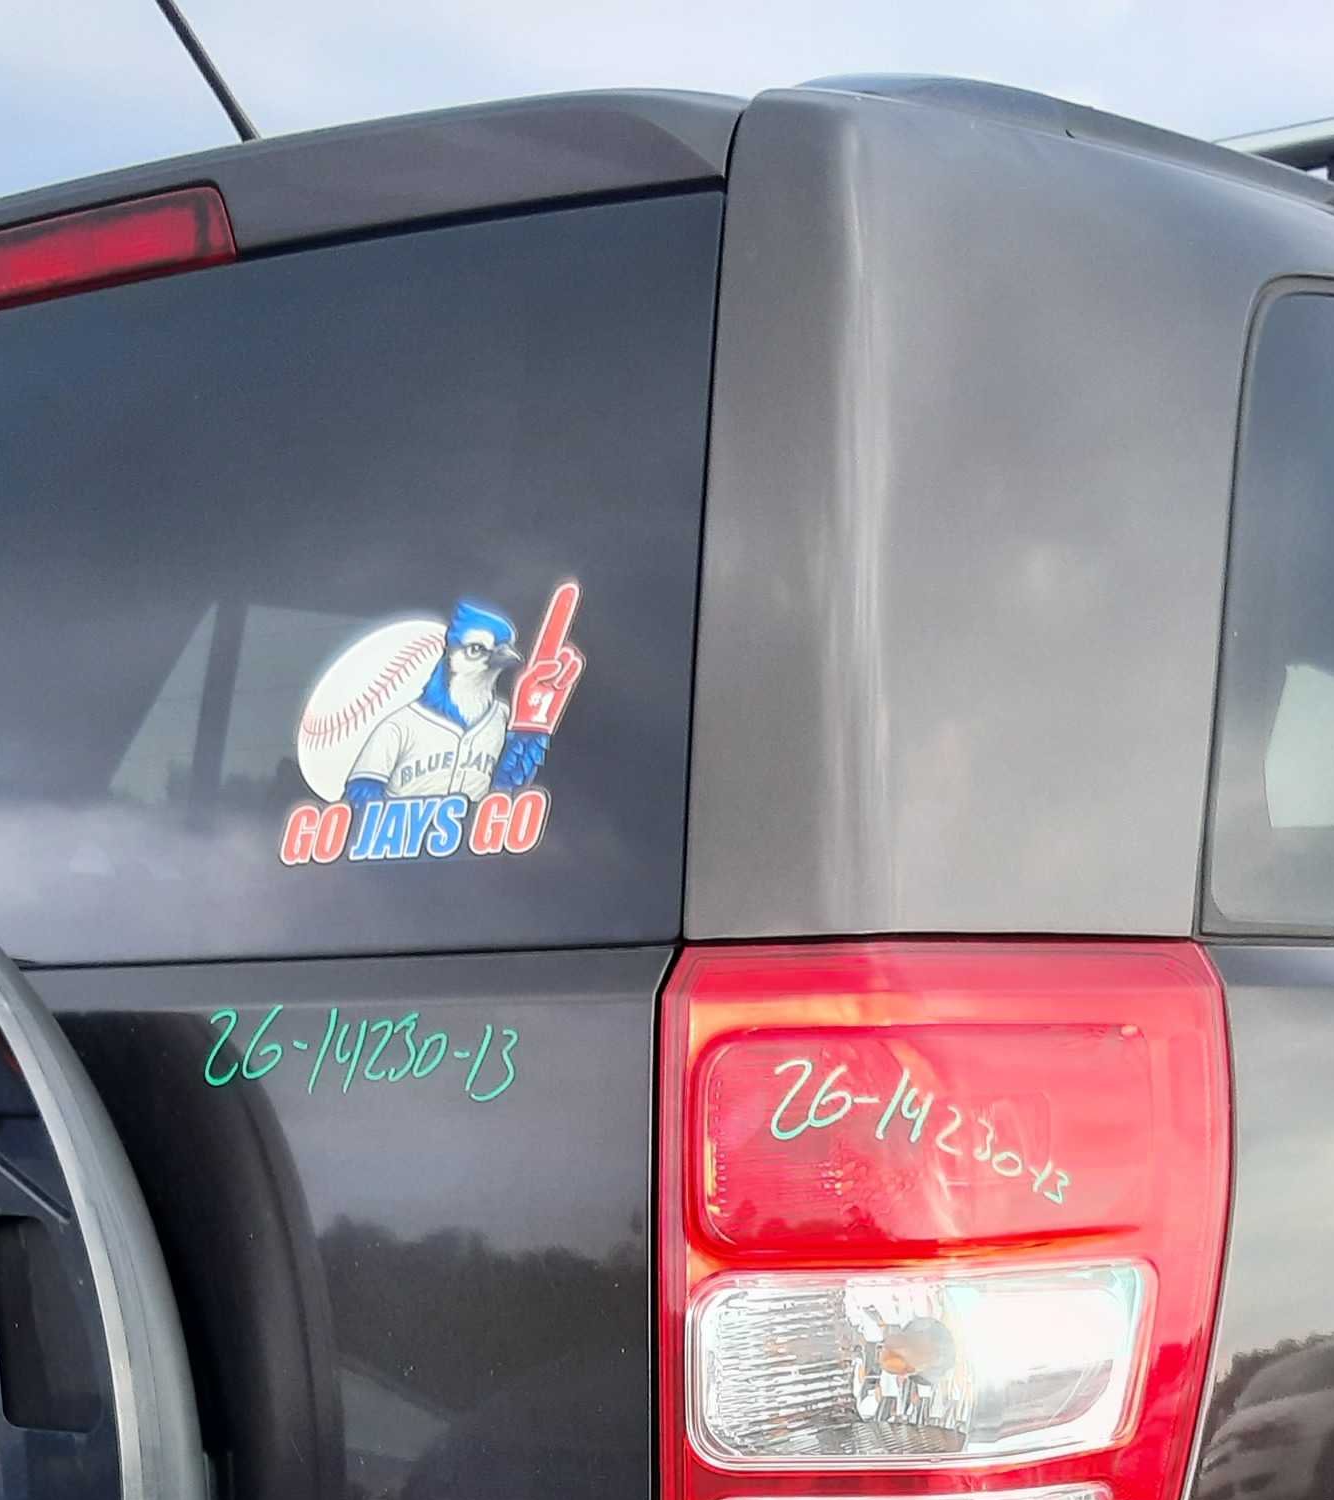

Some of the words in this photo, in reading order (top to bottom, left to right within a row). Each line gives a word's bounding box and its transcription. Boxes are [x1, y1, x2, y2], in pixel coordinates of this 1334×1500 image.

[401, 752, 454, 787] BLUE
[280, 804, 352, 865] GO
[349, 796, 467, 860] JAYS
[469, 791, 547, 855] GO
[205, 1004, 518, 1101] 26-14230-13
